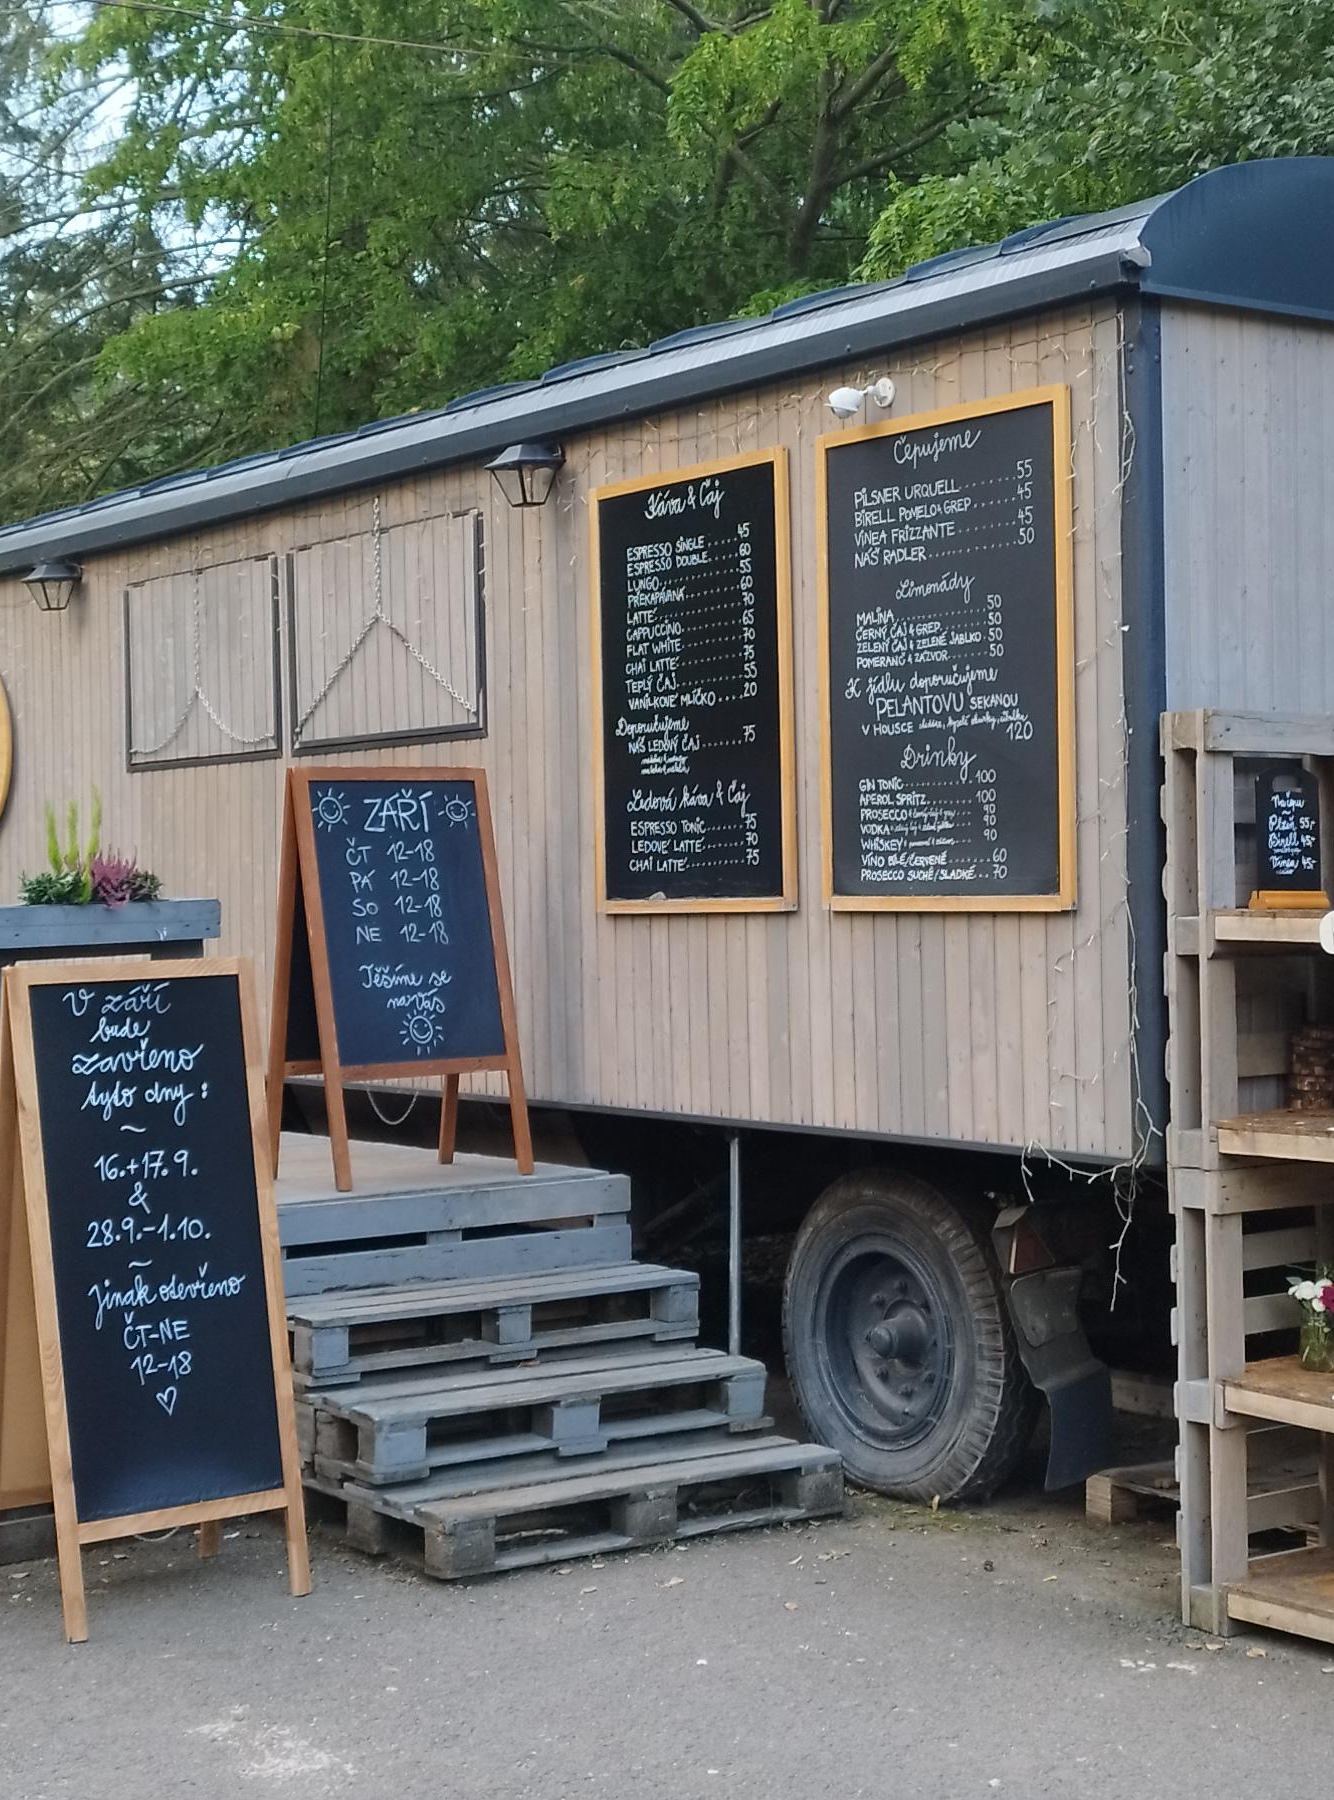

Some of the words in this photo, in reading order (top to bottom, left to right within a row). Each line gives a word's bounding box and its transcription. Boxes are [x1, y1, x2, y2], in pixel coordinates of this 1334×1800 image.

[893, 429, 982, 469] Čepujeme
[904, 478, 960, 500] URQUELL
[1017, 458, 1033, 479] 55
[644, 490, 686, 519] Káva
[687, 486, 696, 510] &
[699, 478, 725, 519] Čaj
[944, 497, 972, 515] GREP
[1017, 481, 1033, 500] 45
[1017, 506, 1034, 525] 45
[627, 542, 672, 561] ESPRESSO
[737, 522, 751, 538] 45
[854, 547, 879, 568] NÁŠ
[883, 546, 927, 566] RADLER
[1017, 527, 1035, 545] 50
[627, 557, 672, 577] ESPRESSO
[675, 551, 708, 568] DOUBLE
[739, 543, 751, 556] 60
[627, 576, 659, 592] LUNGO
[740, 558, 752, 573] 55
[740, 576, 753, 590] 60
[895, 571, 975, 604] Limonády
[742, 592, 754, 606] 70
[987, 594, 1002, 610] 50
[742, 608, 754, 625] 65
[855, 624, 887, 641] ČERNÝ
[890, 620, 907, 639] ČAJ
[915, 621, 941, 636] GREP
[987, 611, 1002, 626] 50
[627, 642, 649, 658] FLAT
[743, 627, 755, 642] 70
[743, 645, 755, 661] 75
[856, 638, 890, 654] ZELENÝ
[891, 637, 907, 653] ČAJ
[916, 631, 948, 650] ZELENÉ
[949, 631, 982, 645] JABLKO
[987, 627, 1003, 642] 50
[856, 652, 906, 669] POMERANČ
[914, 649, 948, 663] ZÁZVOR
[989, 644, 1004, 657] 50
[625, 675, 652, 693] TEPLÝ
[657, 672, 676, 692] ČAJ
[744, 661, 757, 678] 55
[845, 678, 861, 699] K
[866, 672, 905, 705] jídlu
[909, 664, 998, 696] doporučujeme
[680, 687, 715, 706] MLÍČKO
[743, 682, 757, 697] 20
[876, 692, 964, 721] PELANTOVU
[969, 693, 1019, 710] SEKANOU
[615, 714, 689, 740] Doporučujeme
[628, 735, 645, 754] NÁŠ
[648, 734, 679, 753] LEDOVÝ
[681, 733, 700, 751] ČAJ
[743, 724, 756, 742] 75
[873, 721, 914, 736] HOUSCE
[1006, 721, 1033, 740] 120
[900, 736, 977, 784] Drinky
[975, 769, 997, 784] 100
[363, 788, 433, 832] ZÁŘÍ
[627, 788, 677, 812] Ledová
[716, 779, 723, 806] &
[727, 779, 750, 818] Čaj
[859, 793, 894, 807] APEROL
[975, 788, 997, 803] 100
[630, 820, 677, 836] ESPRESSO
[745, 813, 757, 830] 75
[860, 808, 908, 821] PROSECCO
[983, 803, 996, 814] 90
[860, 823, 891, 835] VODKA
[983, 814, 996, 826] 90
[631, 839, 671, 854] LEDOVÉ
[745, 832, 758, 846] 70
[983, 828, 997, 841] 90
[346, 837, 371, 866] ČT
[387, 838, 435, 863] 12-18
[746, 849, 760, 865] 75
[861, 852, 885, 867] VÍNO
[992, 848, 1007, 862] 60
[349, 869, 375, 893] PÁ
[390, 867, 440, 891] 12-18
[861, 869, 904, 882] PROSECCO
[992, 864, 1007, 879] 70
[352, 898, 379, 917] SO
[394, 894, 442, 918] 12-18
[356, 926, 382, 945] NE
[399, 920, 449, 945] 12-18
[359, 963, 423, 989] Těšíme
[429, 970, 452, 988] se
[62, 988, 95, 1016] V
[100, 982, 171, 1015] září
[89, 1016, 151, 1042] bude
[72, 1037, 205, 1075] zavřeno
[80, 1081, 137, 1122] tyto
[128, 1181, 151, 1215] &
[158, 1262, 246, 1302] otevřeno
[123, 1311, 191, 1350] ČT-NE
[130, 1351, 192, 1386] 12-18
